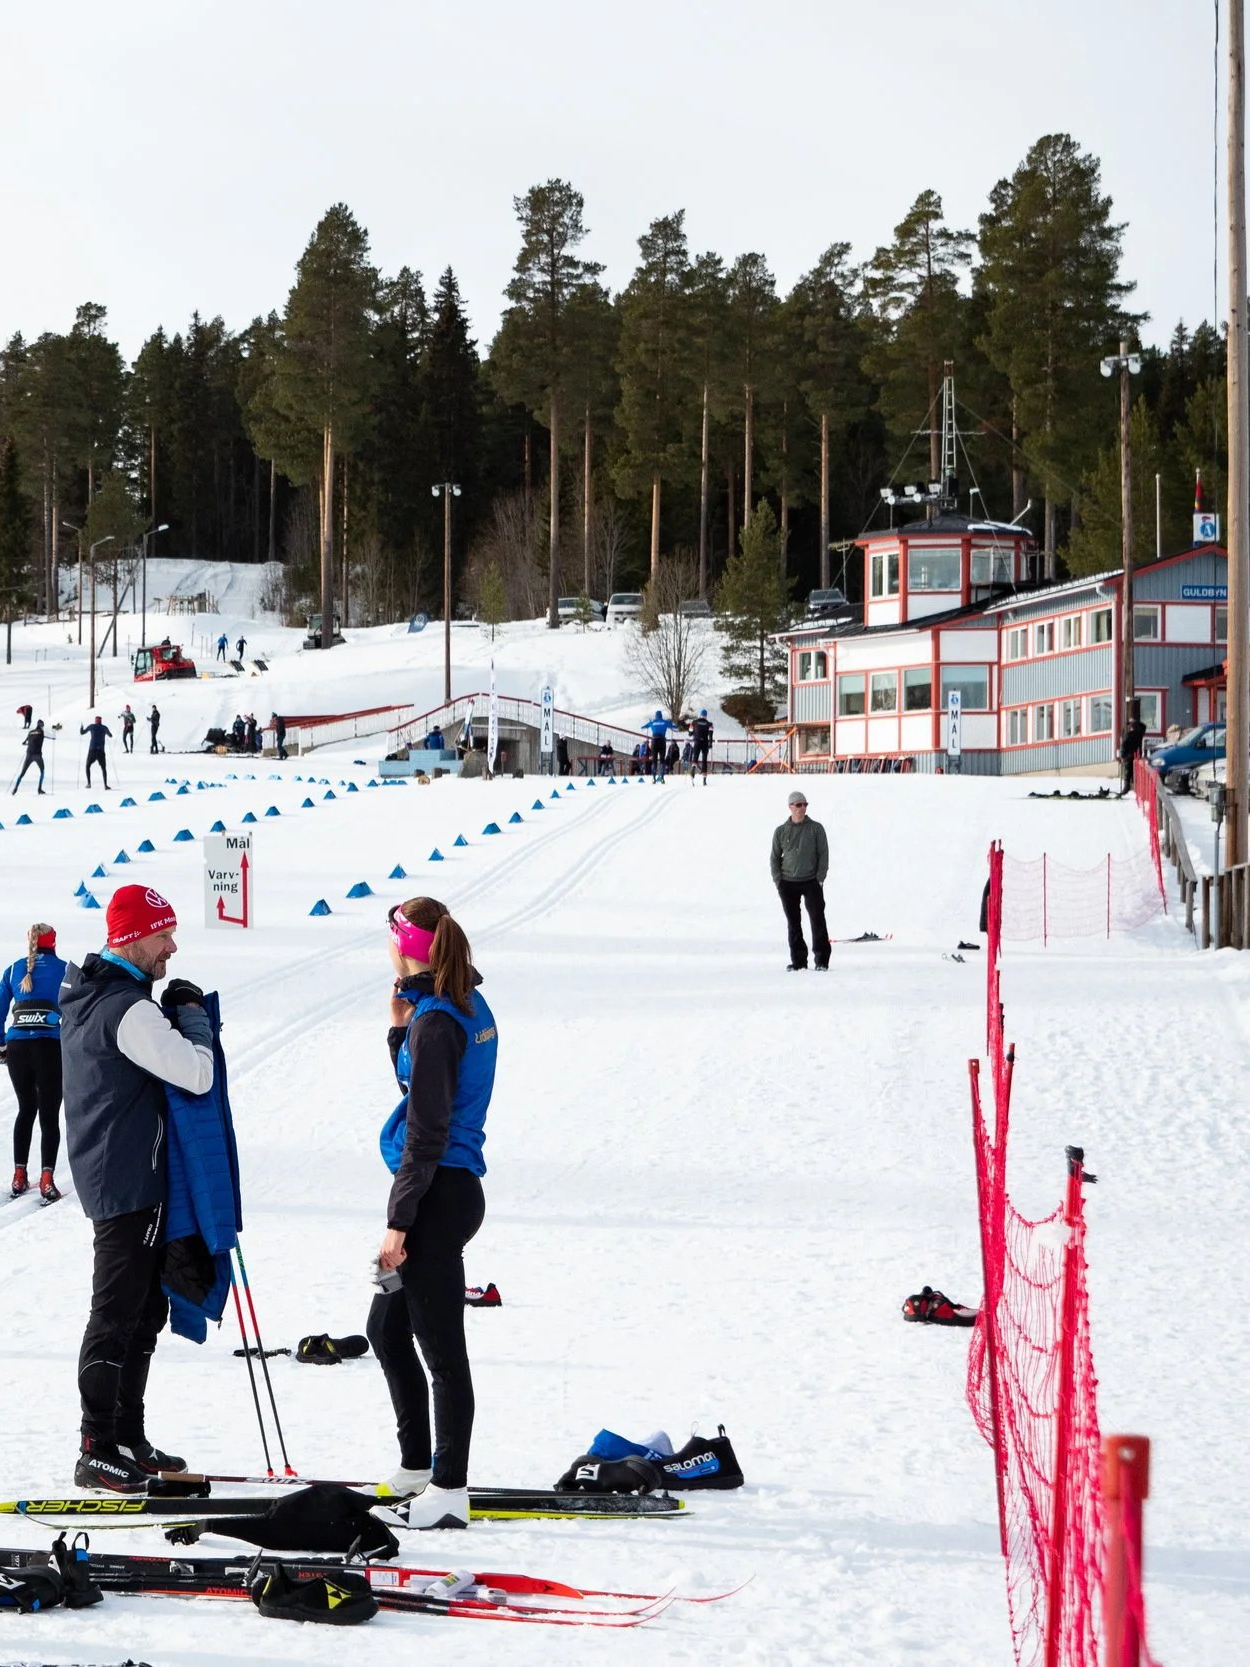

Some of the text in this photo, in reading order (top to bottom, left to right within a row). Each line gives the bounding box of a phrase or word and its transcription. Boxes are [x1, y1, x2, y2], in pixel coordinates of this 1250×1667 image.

[226, 836, 250, 849] Mål
[208, 870, 240, 880] Varv-
[213, 881, 239, 894] ning
[88, 1458, 130, 1479] ATOMIC
[26, 1500, 147, 1512] FISCHER
